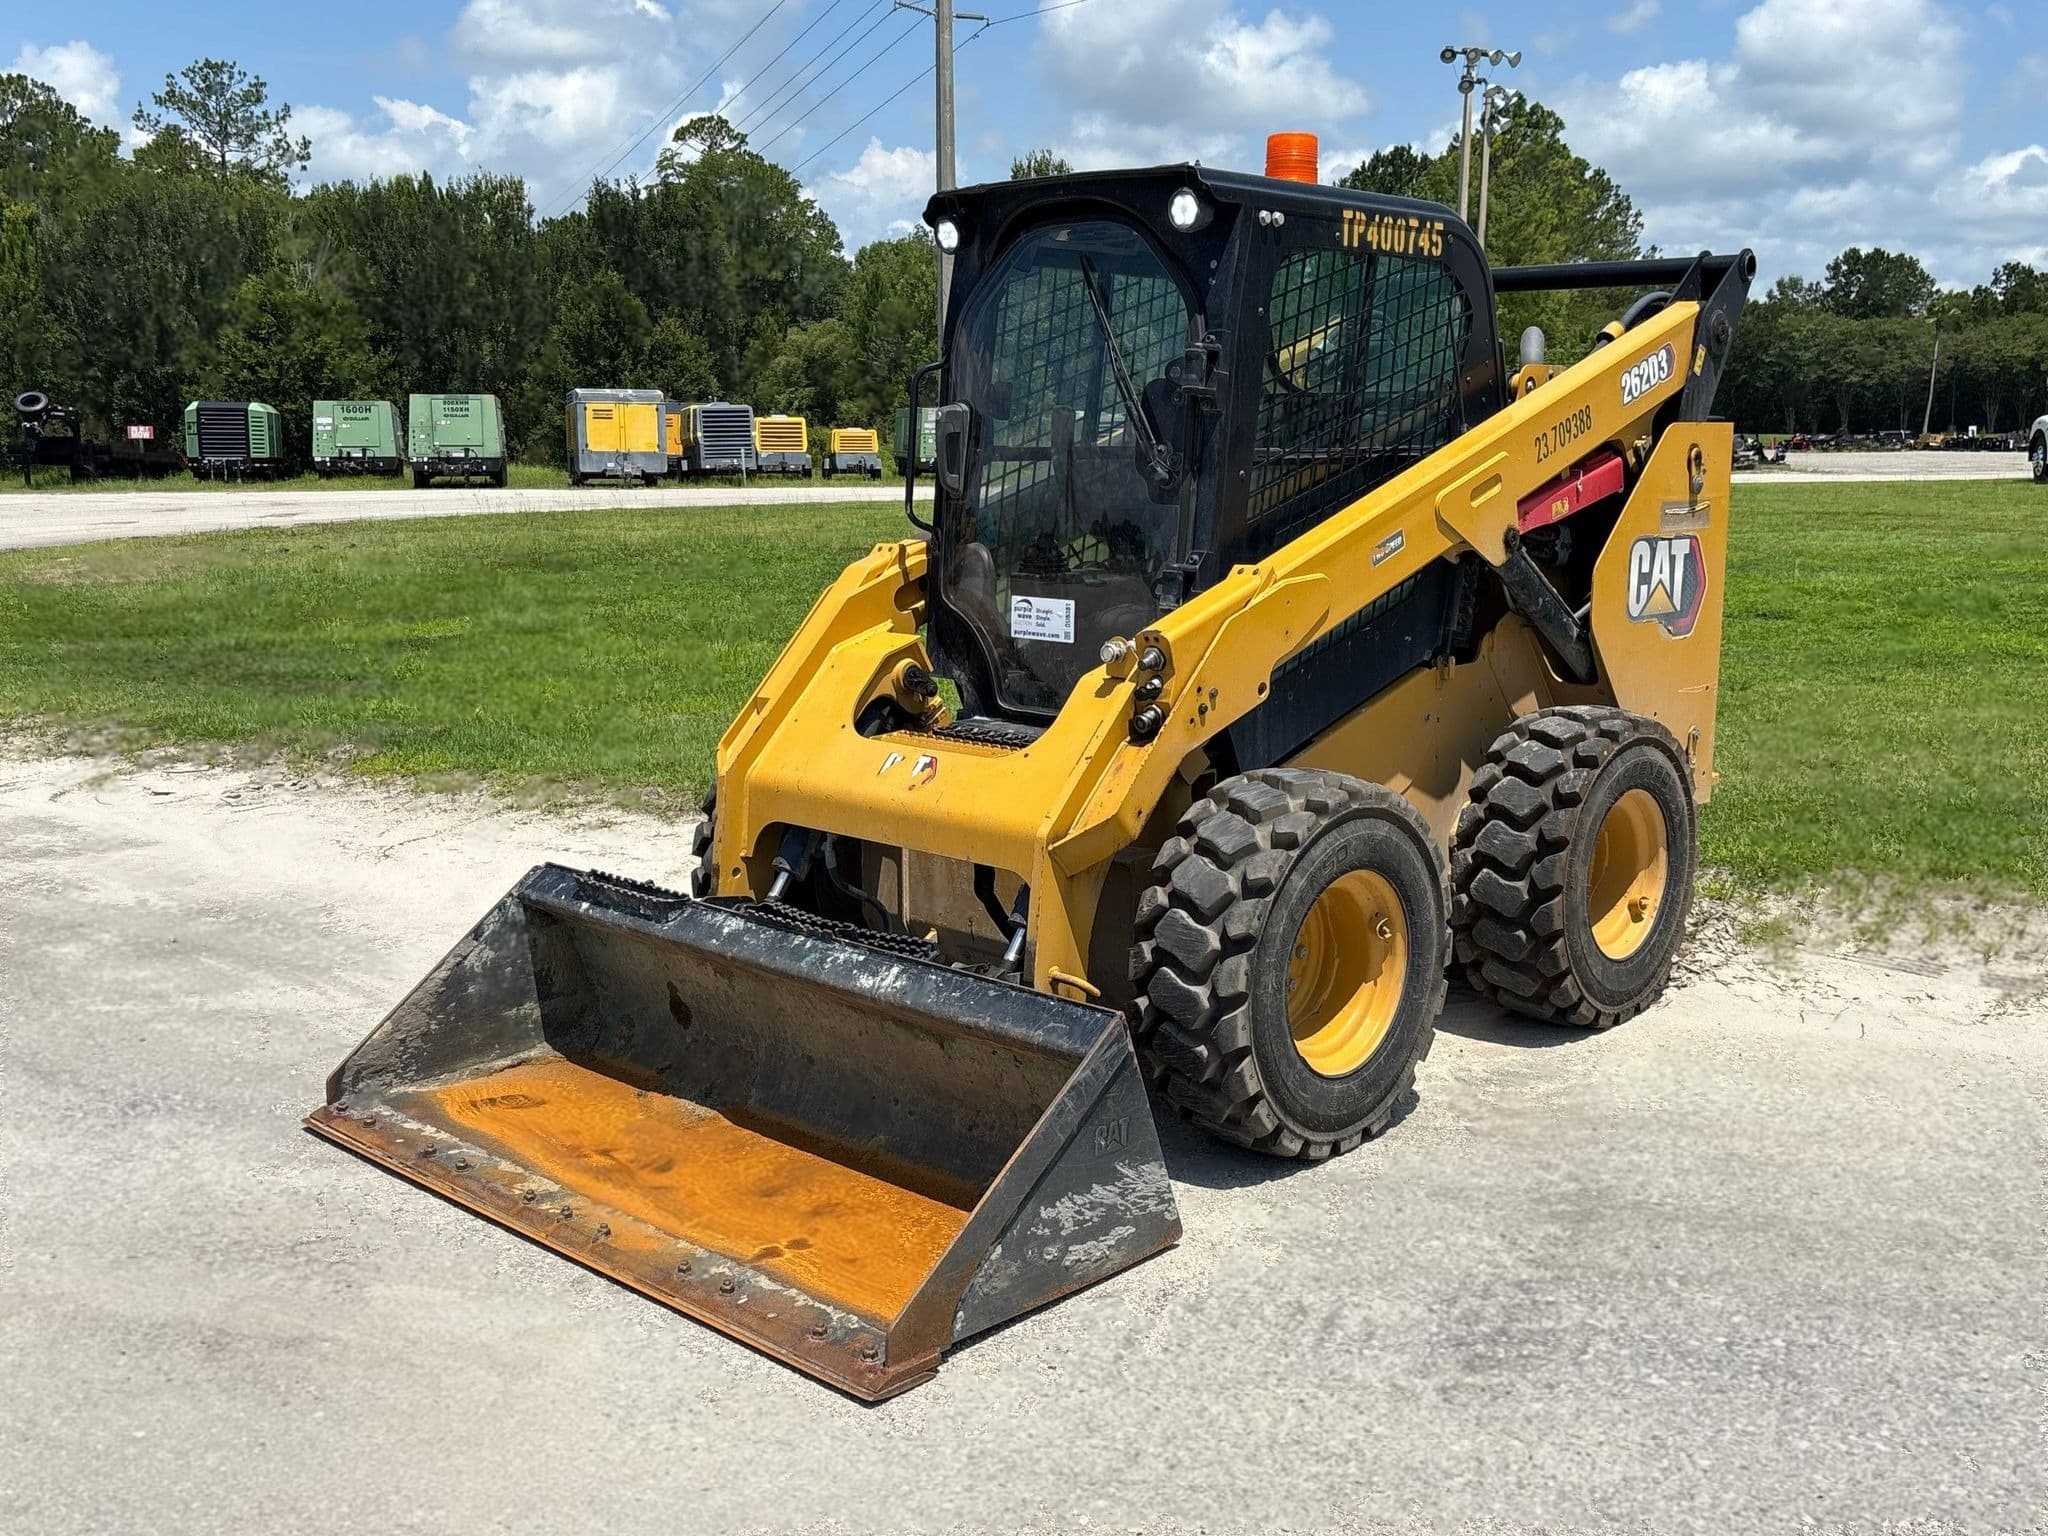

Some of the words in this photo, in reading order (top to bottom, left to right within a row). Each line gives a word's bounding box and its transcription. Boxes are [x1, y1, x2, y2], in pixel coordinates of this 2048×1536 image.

[1342, 208, 1444, 257] TP400745
[1620, 347, 1669, 405] 262D3
[340, 405, 372, 414] 1600H
[1534, 404, 1592, 465] 23.709388
[1628, 539, 1691, 618] CAT
[1014, 629, 1060, 639] purplewave.com
